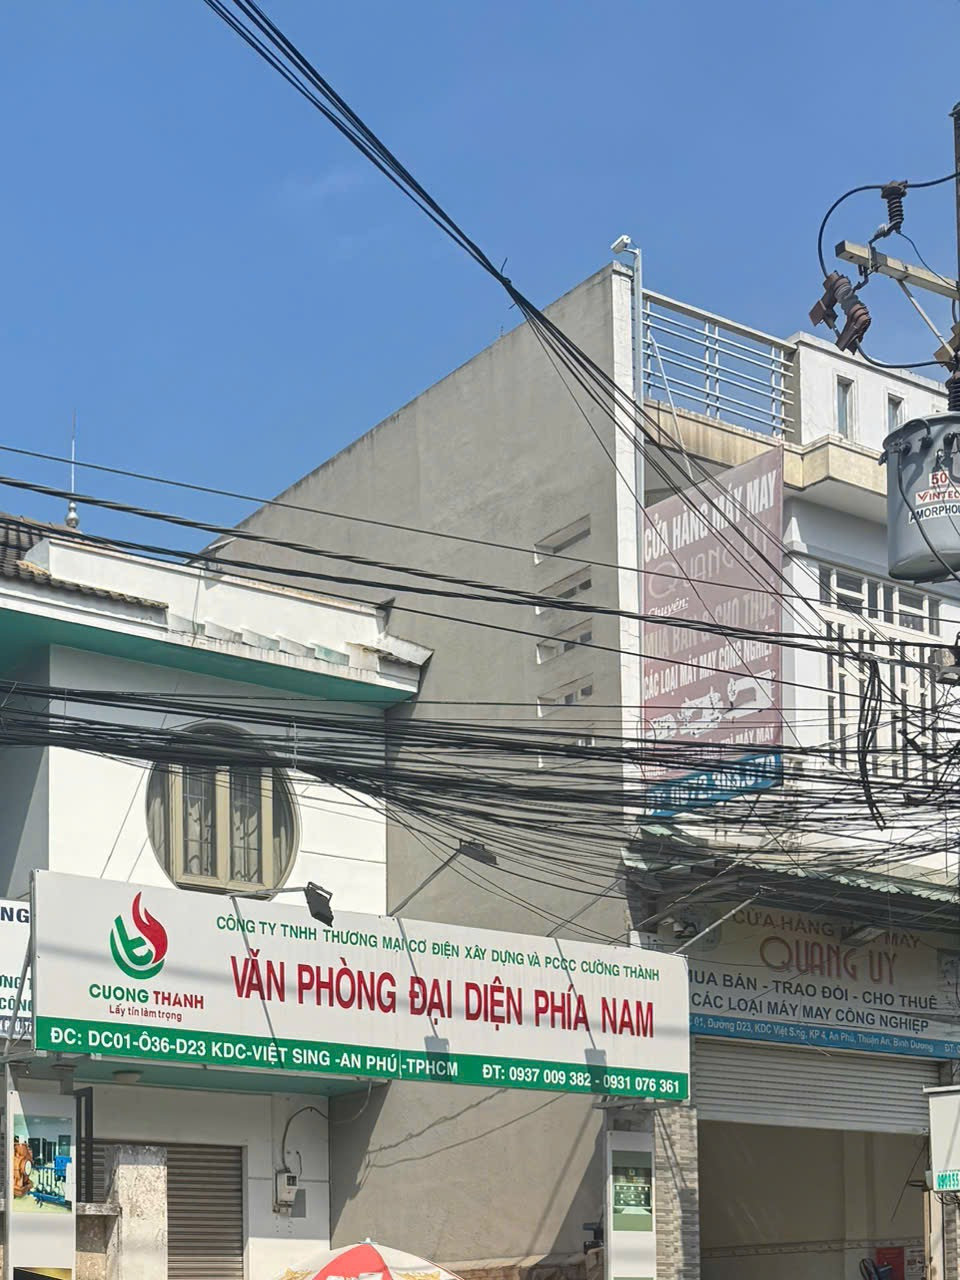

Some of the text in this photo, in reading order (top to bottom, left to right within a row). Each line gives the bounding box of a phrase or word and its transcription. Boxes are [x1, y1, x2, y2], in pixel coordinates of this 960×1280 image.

[931, 471, 948, 486] 50
[644, 469, 777, 563] CỬA HÀNG MÁY MAY
[643, 668, 660, 701] CÁC
[660, 664, 679, 696] LOẠI
[680, 654, 698, 687] MÁY
[699, 649, 718, 681] MAY
[732, 907, 777, 930] CỬA
[782, 914, 835, 937] HÀNG
[216, 913, 660, 981] CÔNG TY TNHH THƯƠNG MẠI CƠ ĐIỆN XÂY DỰNG VÀ PCCC CƯỜNG THÀNH
[759, 935, 857, 982] QUANG
[89, 983, 205, 1010] CUONG THANH
[230, 948, 654, 1038] VĂN PHÒNG ĐẠI DIỆN PHÍA NAM
[722, 972, 758, 991] BÁN
[772, 979, 818, 997] TRAO
[862, 990, 895, 1006] CHO
[898, 994, 939, 1010] THUÊ
[4, 1019, 23, 1033] PÚ,
[109, 1003, 183, 1023] Lấy tín làm trọng
[691, 991, 929, 1035] CÁC LOẠI MÁY MAY CÔNG NGHIỆP
[707, 1018, 735, 1033] Đường
[50, 1027, 82, 1046] ĐC:
[88, 1029, 207, 1057] DC01-Ô36-D23
[211, 1041, 288, 1065] KDC-VIỆT
[292, 1048, 331, 1066] SING
[366, 1053, 398, 1073] PHÚ
[401, 1057, 459, 1077] -TPHCM
[482, 1063, 506, 1080] ĐT:
[508, 1065, 540, 1082] 0937
[543, 1069, 567, 1085] 009
[569, 1072, 592, 1087] 382
[603, 1074, 632, 1090] 0931
[635, 1077, 657, 1092] 076
[659, 1079, 680, 1094] 361
